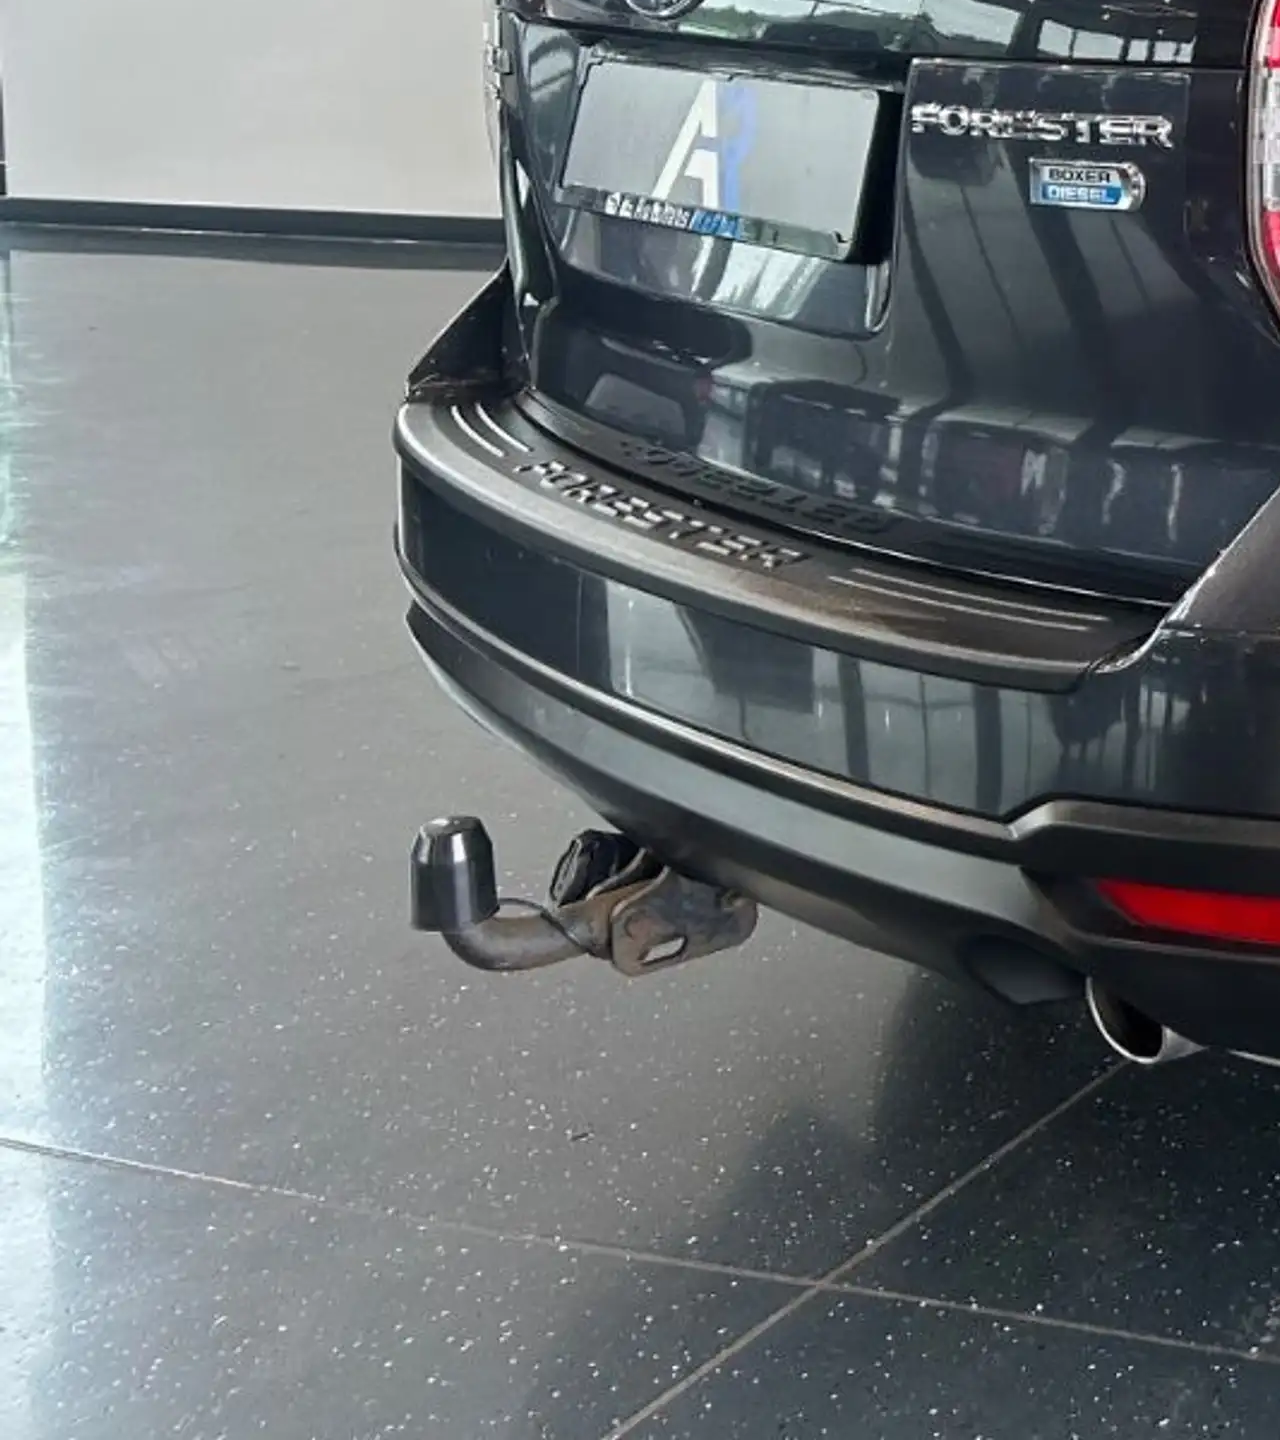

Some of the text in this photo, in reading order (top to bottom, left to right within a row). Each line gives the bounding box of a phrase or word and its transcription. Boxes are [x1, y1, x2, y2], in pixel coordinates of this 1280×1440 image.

[911, 102, 1174, 149] FORESTER
[1049, 165, 1111, 183] BOXER
[1047, 183, 1110, 200] DIESEL
